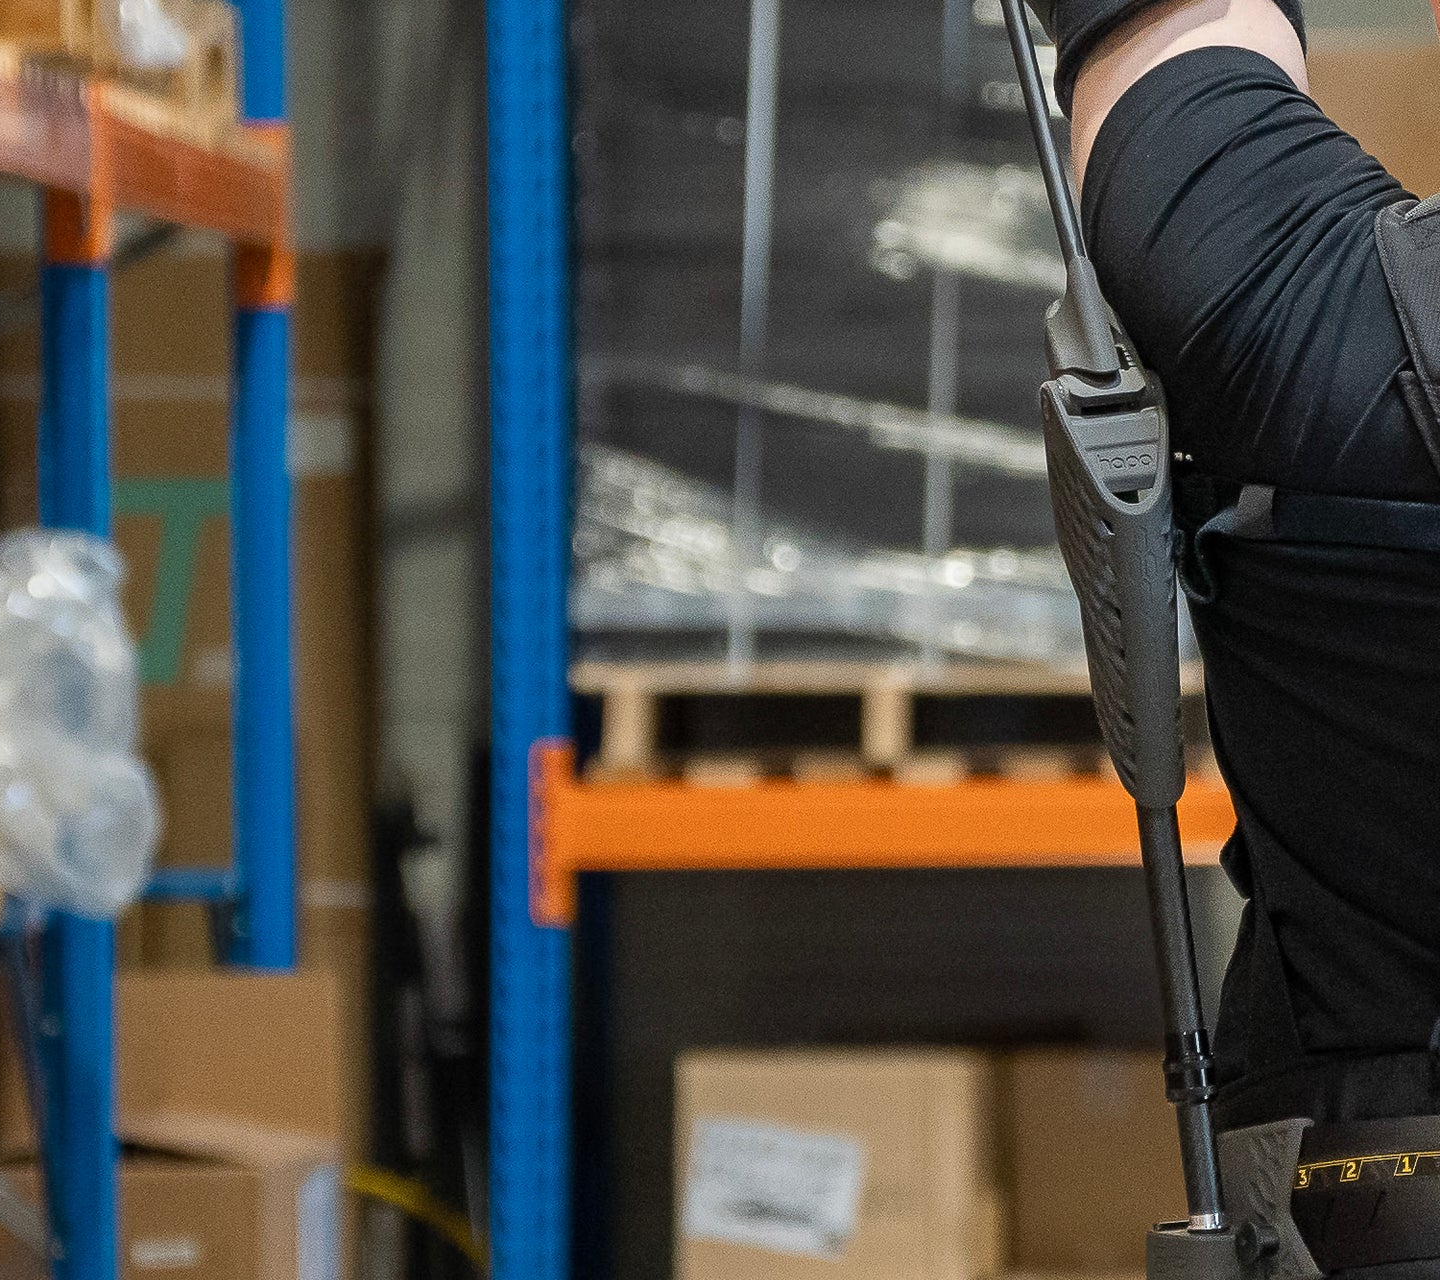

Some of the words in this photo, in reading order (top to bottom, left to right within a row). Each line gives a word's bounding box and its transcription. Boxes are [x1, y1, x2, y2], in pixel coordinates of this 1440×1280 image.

[1298, 1169, 1308, 1186] 3
[1346, 1161, 1358, 1179] 2
[1401, 1156, 1412, 1174] 1
